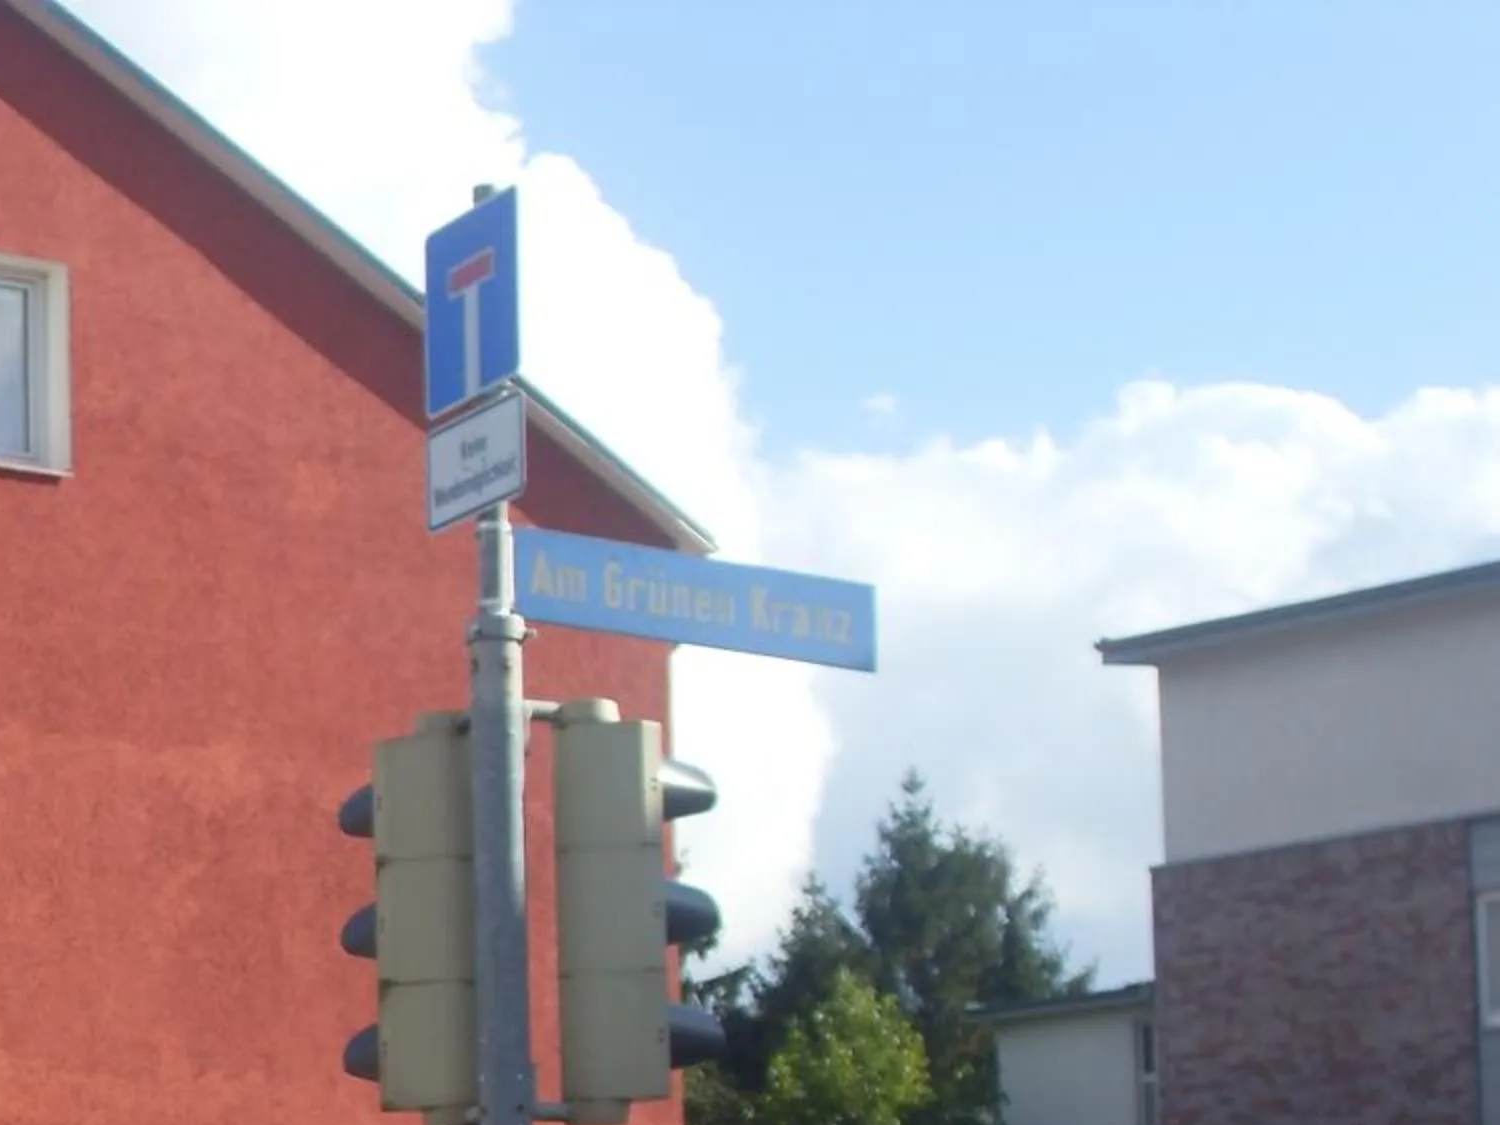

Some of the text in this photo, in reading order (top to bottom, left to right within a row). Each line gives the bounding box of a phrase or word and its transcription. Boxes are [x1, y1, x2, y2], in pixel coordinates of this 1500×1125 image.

[531, 550, 852, 643] Am Grünen Kranz
